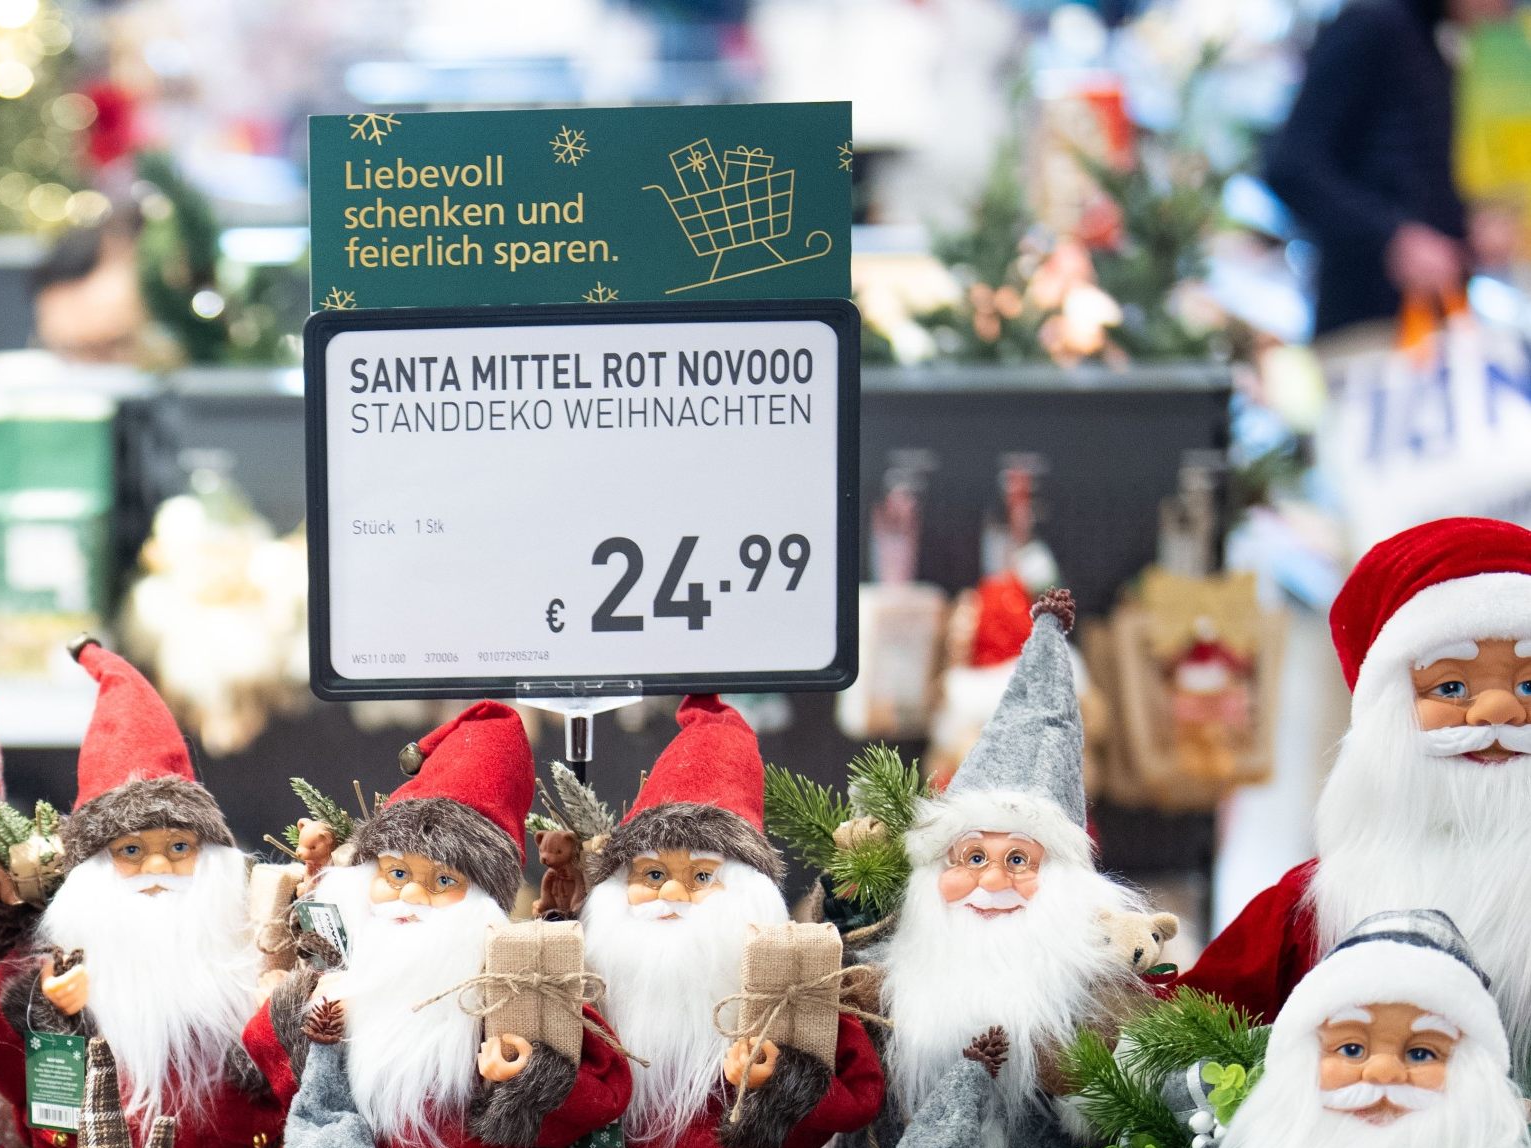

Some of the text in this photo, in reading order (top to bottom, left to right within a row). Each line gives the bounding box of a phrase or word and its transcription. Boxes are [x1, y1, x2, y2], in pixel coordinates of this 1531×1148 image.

[344, 154, 504, 190] Liebevoll
[343, 192, 585, 230] schenken und
[343, 235, 620, 273] feierlich sparen.
[350, 347, 814, 395] SANTA MITTEL ROT NOVOOO
[351, 393, 813, 435] STANDDEKO WEIHNACHTEN
[351, 518, 396, 536] Stück
[425, 517, 445, 535] Stk
[545, 533, 812, 635] € 24.99
